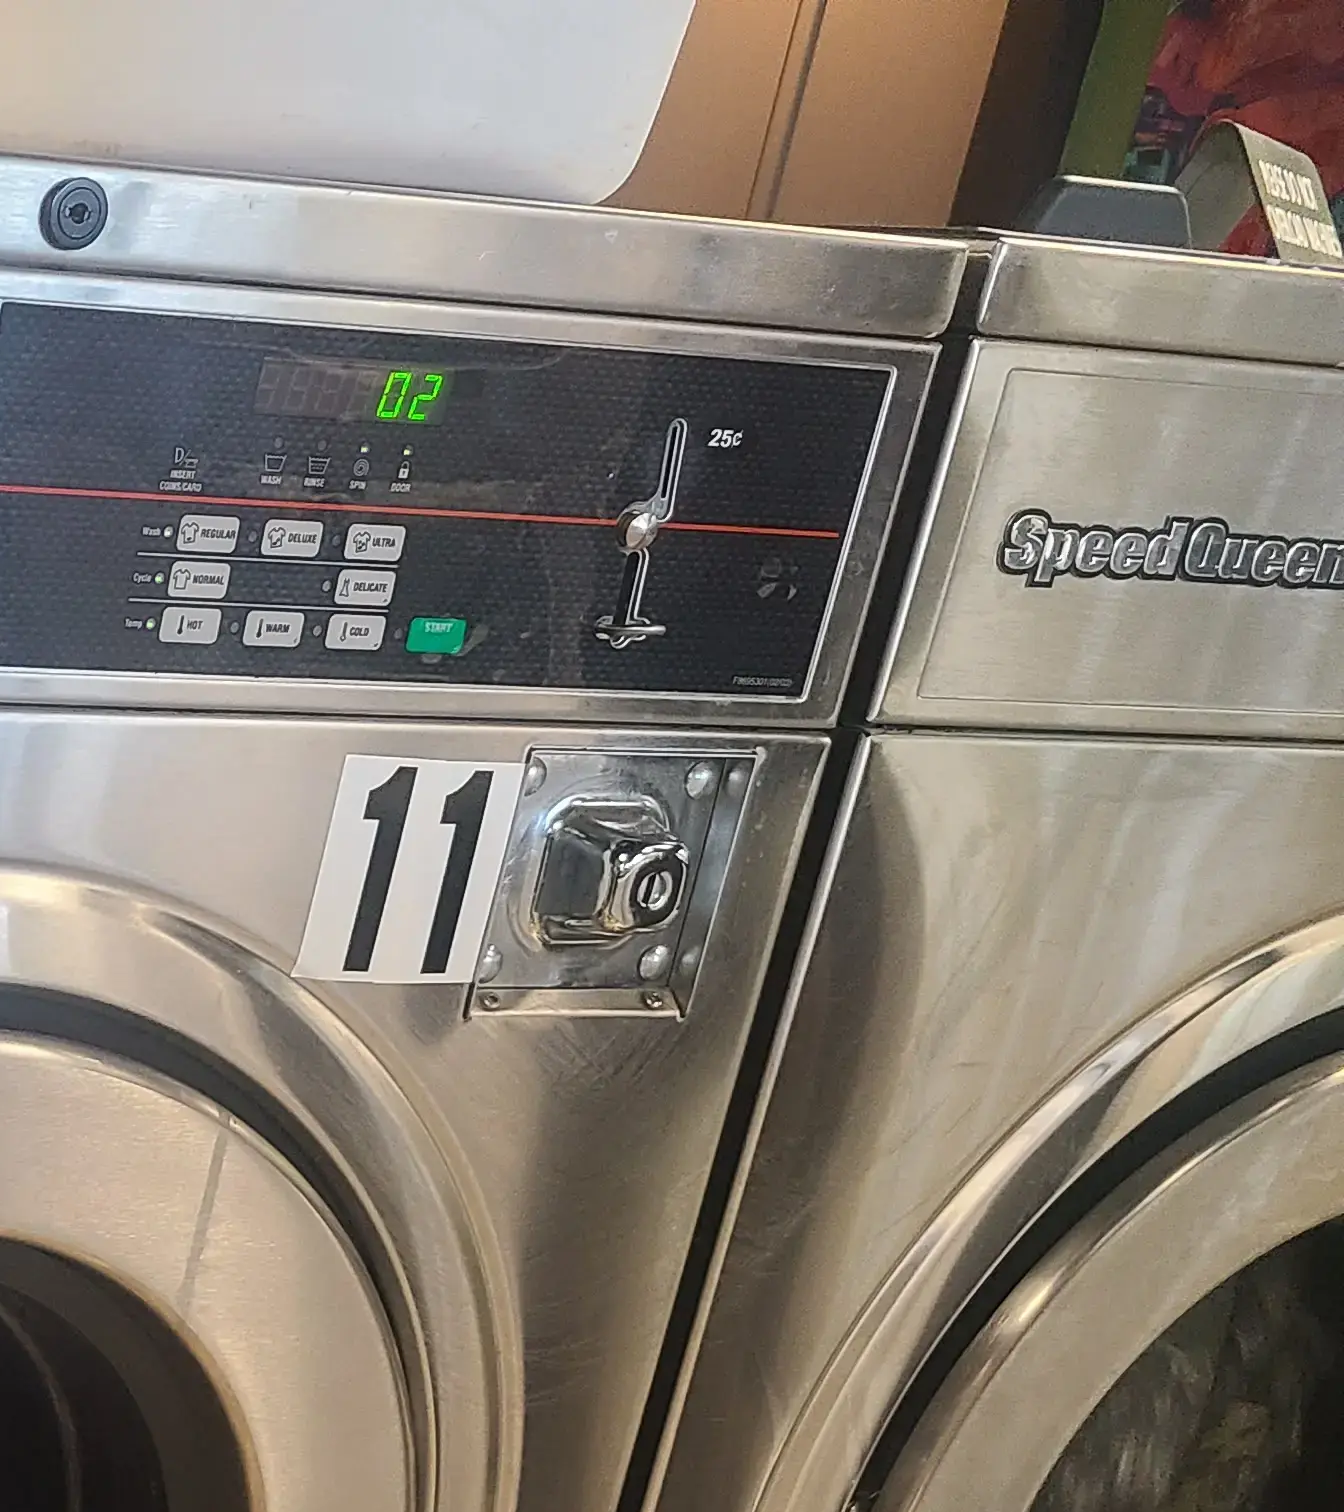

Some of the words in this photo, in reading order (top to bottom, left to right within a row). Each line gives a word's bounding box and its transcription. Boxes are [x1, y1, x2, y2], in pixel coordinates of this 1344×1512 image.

[376, 371, 443, 420] 02
[707, 428, 744, 449] 25¢
[170, 470, 196, 480] INSERT
[261, 475, 282, 485] WASH
[304, 477, 325, 488] RINSE
[349, 480, 367, 490] SPIN
[390, 482, 411, 492] DOOR
[200, 528, 236, 540] REGULAR
[287, 532, 317, 545] DELUXE
[372, 536, 396, 548] ULTRA
[133, 572, 152, 584] Cycle
[192, 574, 225, 586] NORMAL
[353, 581, 388, 593] DELICATE
[187, 620, 203, 630] HOT
[265, 622, 291, 634] WARM
[424, 621, 452, 634] START
[350, 626, 370, 637] COLD
[342, 765, 495, 974] 11
